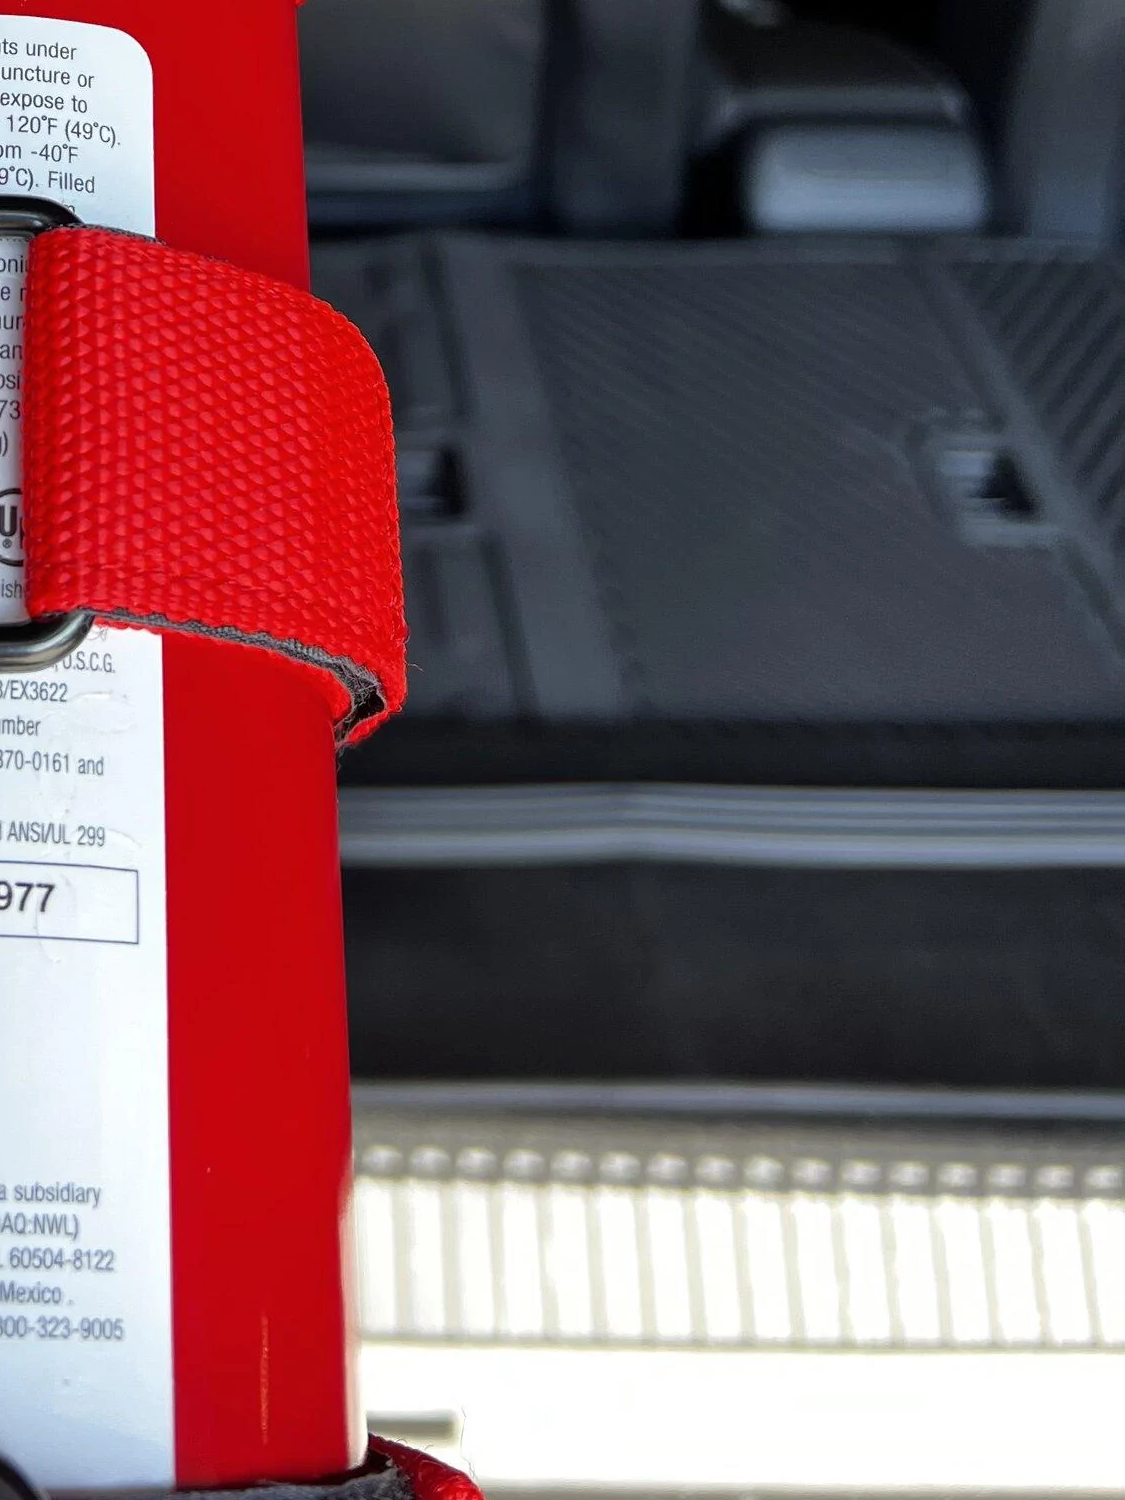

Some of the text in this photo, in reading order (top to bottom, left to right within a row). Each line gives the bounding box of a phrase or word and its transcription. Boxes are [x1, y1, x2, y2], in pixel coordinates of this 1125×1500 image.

[26, 43, 77, 60] under
[78, 74, 94, 88] or
[0, 93, 64, 110] expose
[71, 95, 87, 113] to
[7, 115, 57, 135] 120°F
[62, 120, 120, 151] (49°C).
[31, 144, 78, 163] -40°F
[48, 171, 94, 193] Filled
[78, 756, 104, 776] and
[7, 821, 71, 845] ANSI/UL
[77, 825, 105, 847] 299
[14, 1182, 101, 1208] subsidiary
[9, 1247, 114, 1272] 60504-8122
